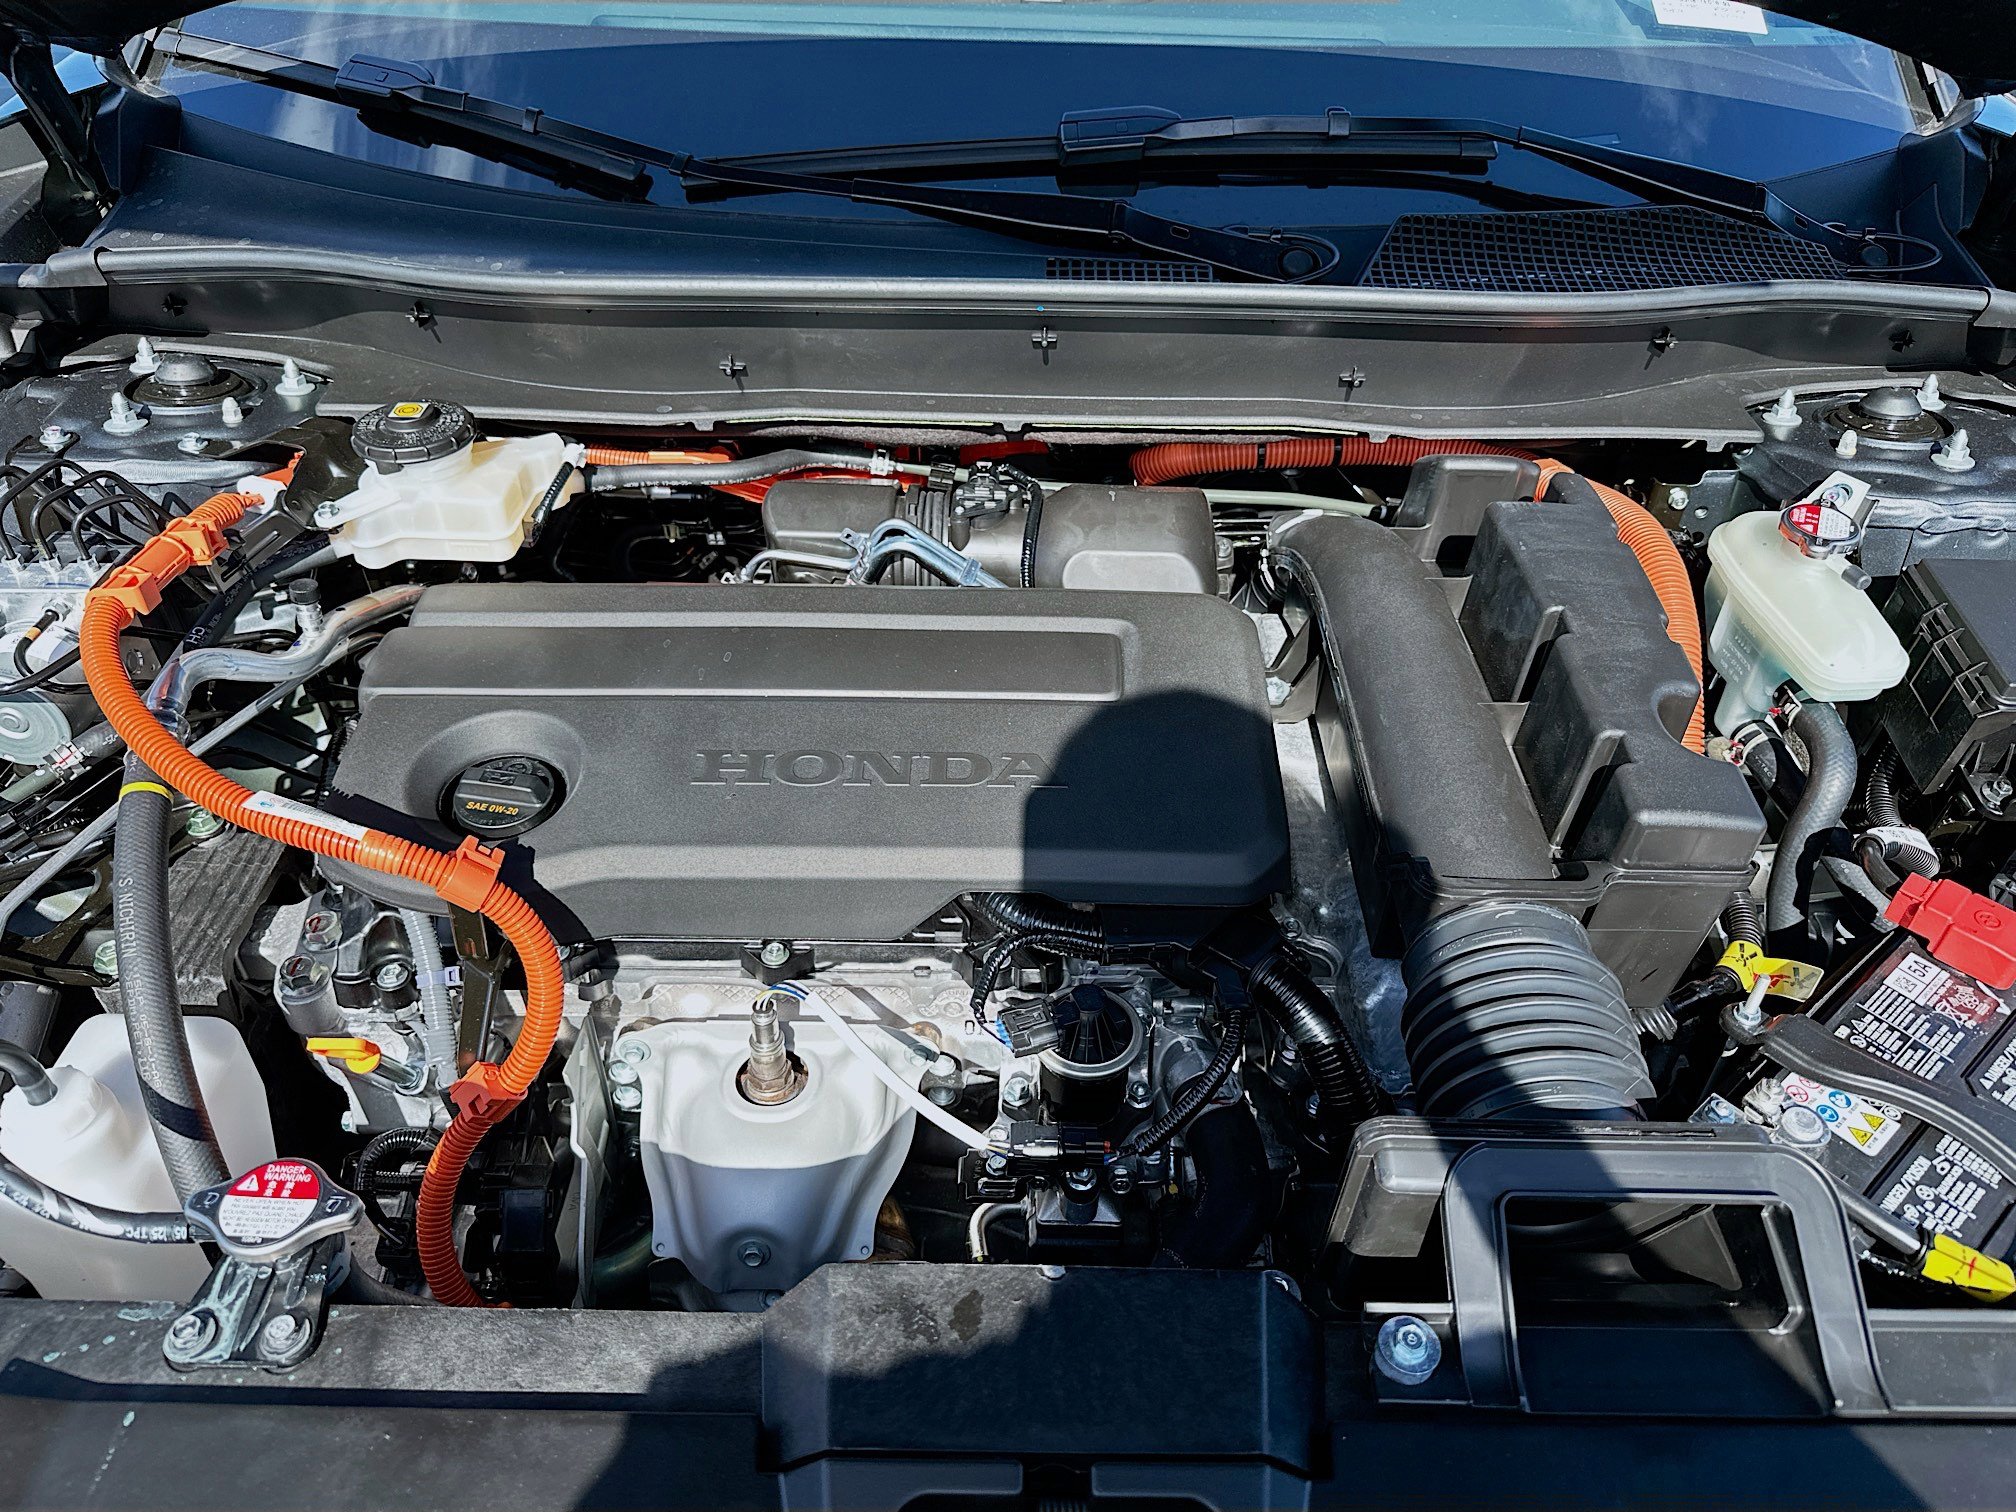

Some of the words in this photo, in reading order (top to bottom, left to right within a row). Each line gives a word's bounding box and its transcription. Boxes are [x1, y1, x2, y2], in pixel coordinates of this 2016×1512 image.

[690, 749, 1068, 789] HONDA
[466, 802, 487, 811] SAE
[489, 804, 518, 815] 0W-20
[1906, 957, 1932, 978] 5A
[267, 1164, 306, 1173] DANGER
[264, 1172, 312, 1182] WARNUNG
[124, 1227, 147, 1238] TPC
